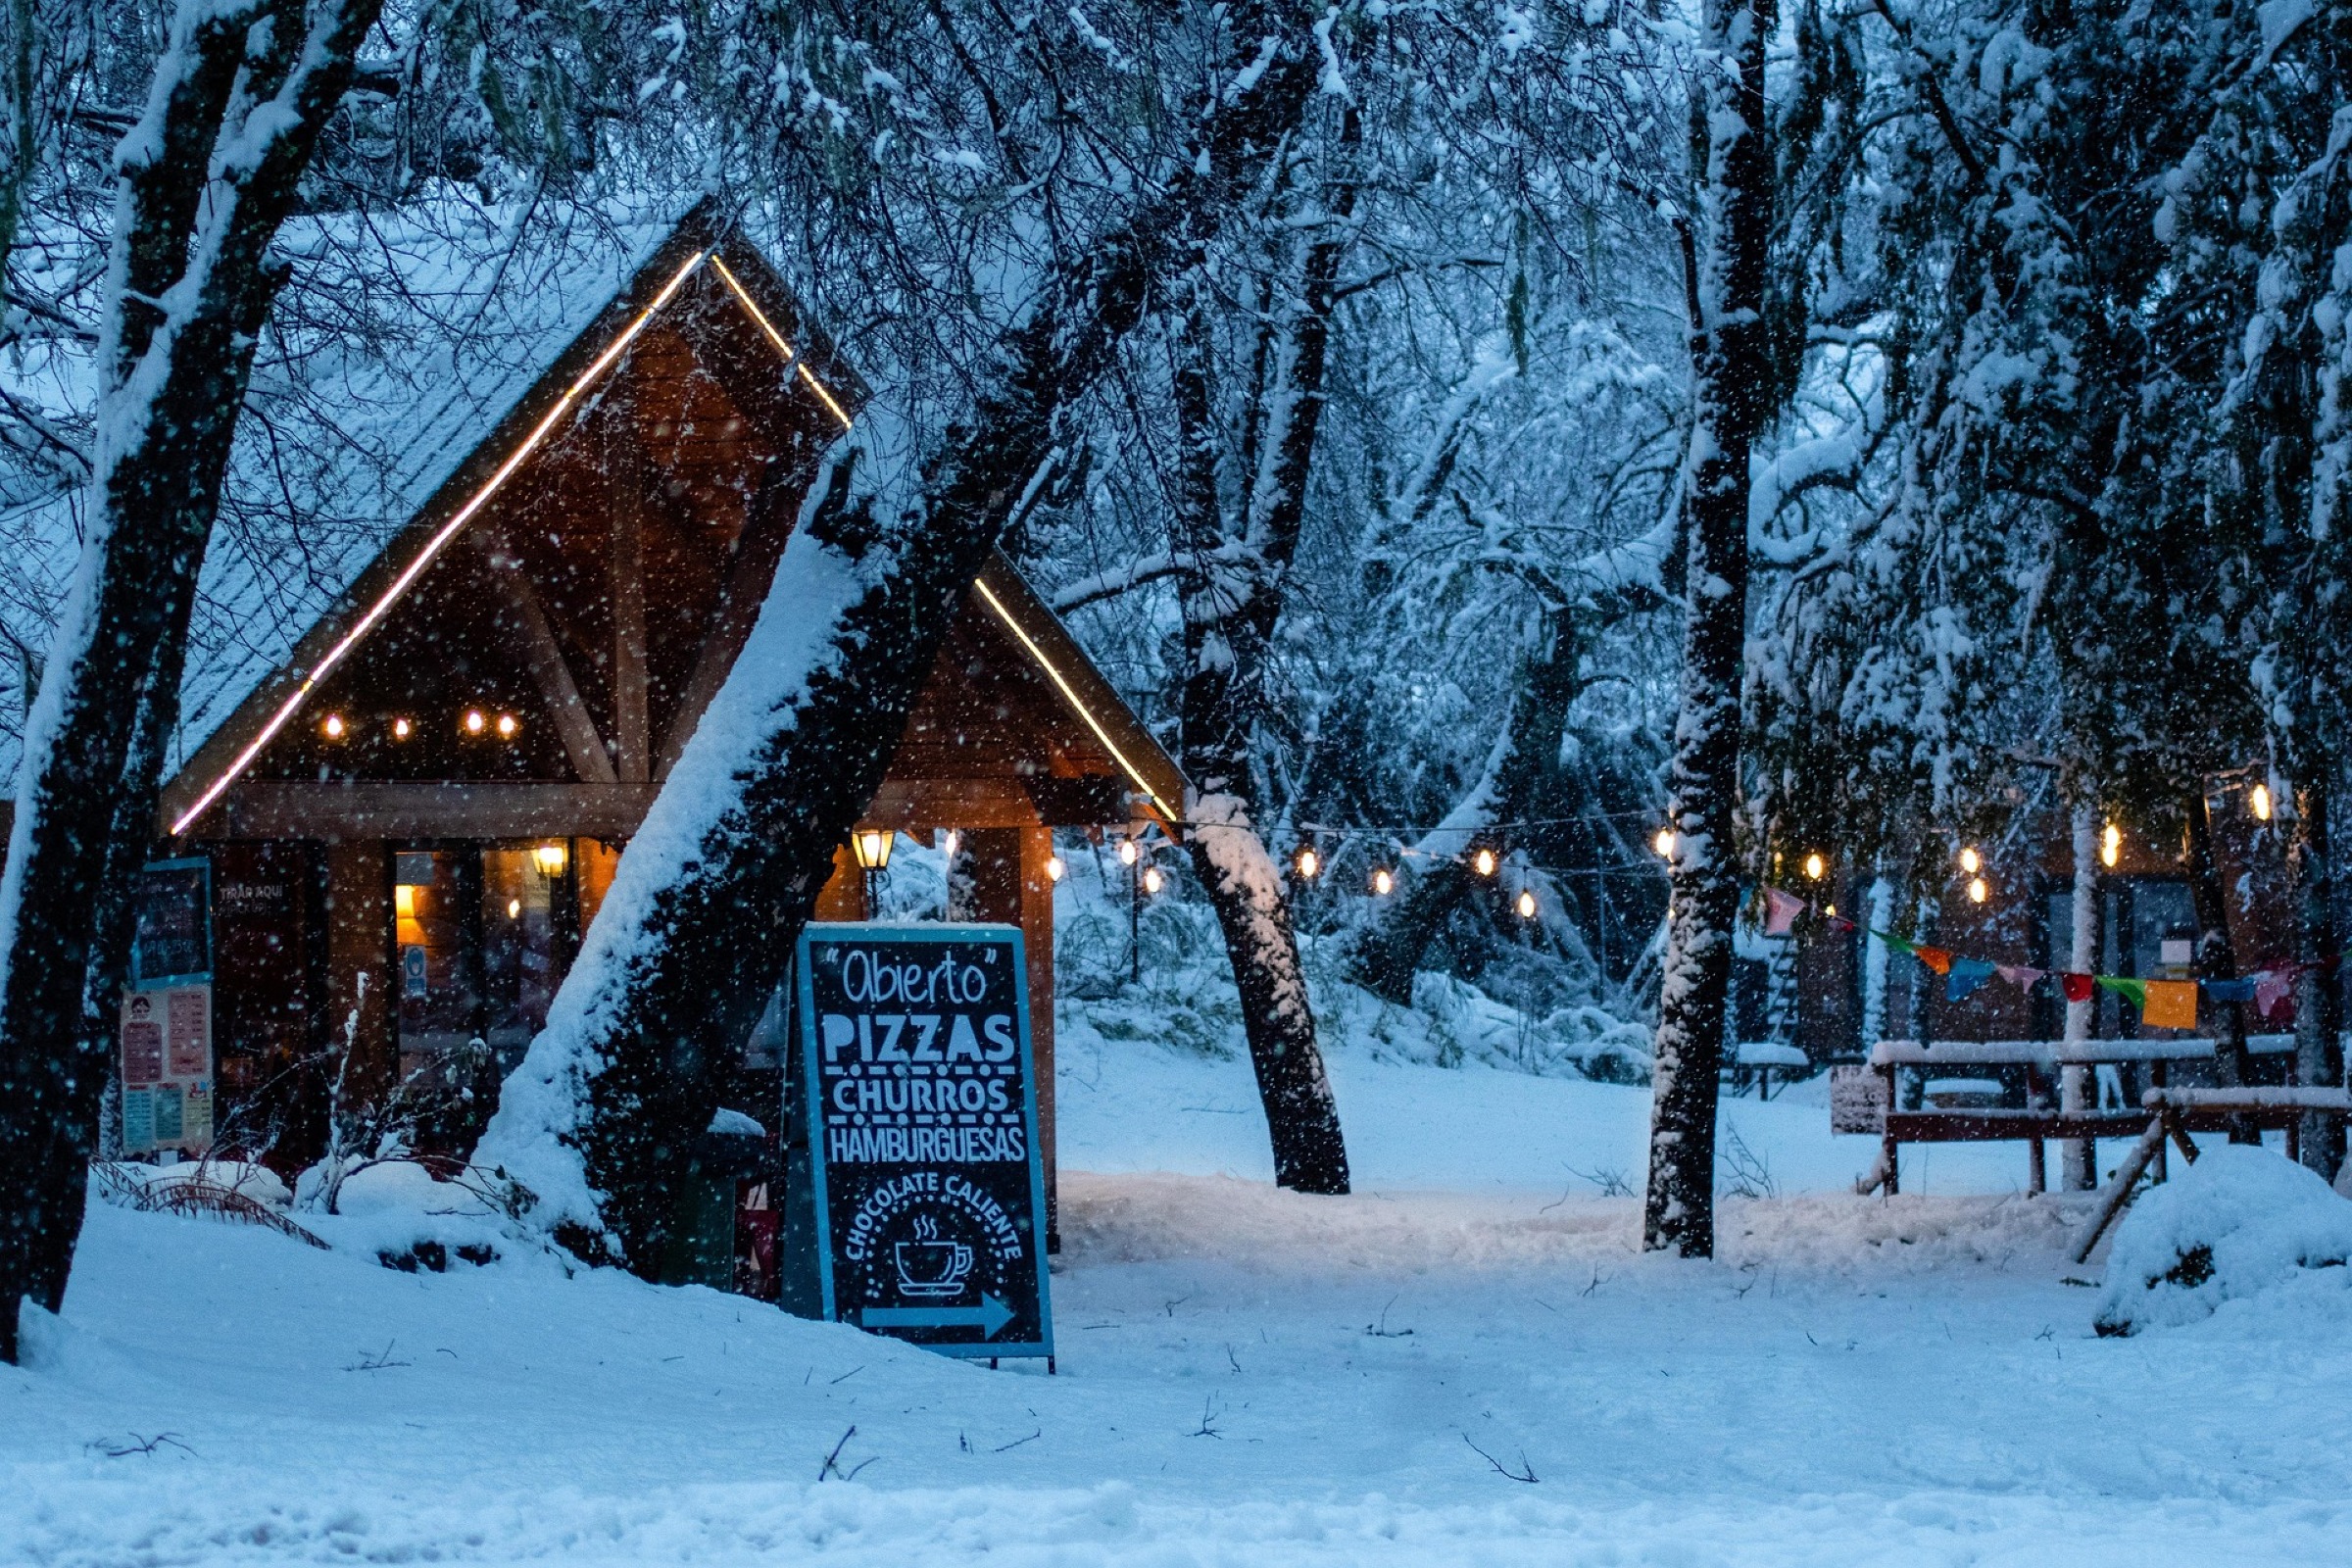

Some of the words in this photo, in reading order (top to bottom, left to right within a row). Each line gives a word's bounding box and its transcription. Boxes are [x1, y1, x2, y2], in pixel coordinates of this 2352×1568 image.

[822, 1013, 1015, 1062] PIZZAS
[833, 1079, 1009, 1113] CHURROS
[829, 1127, 1026, 1163] HAMBURGUESAS
[845, 1172, 940, 1261] CHOCOLATE
[945, 1175, 1023, 1260] CALIENTE
